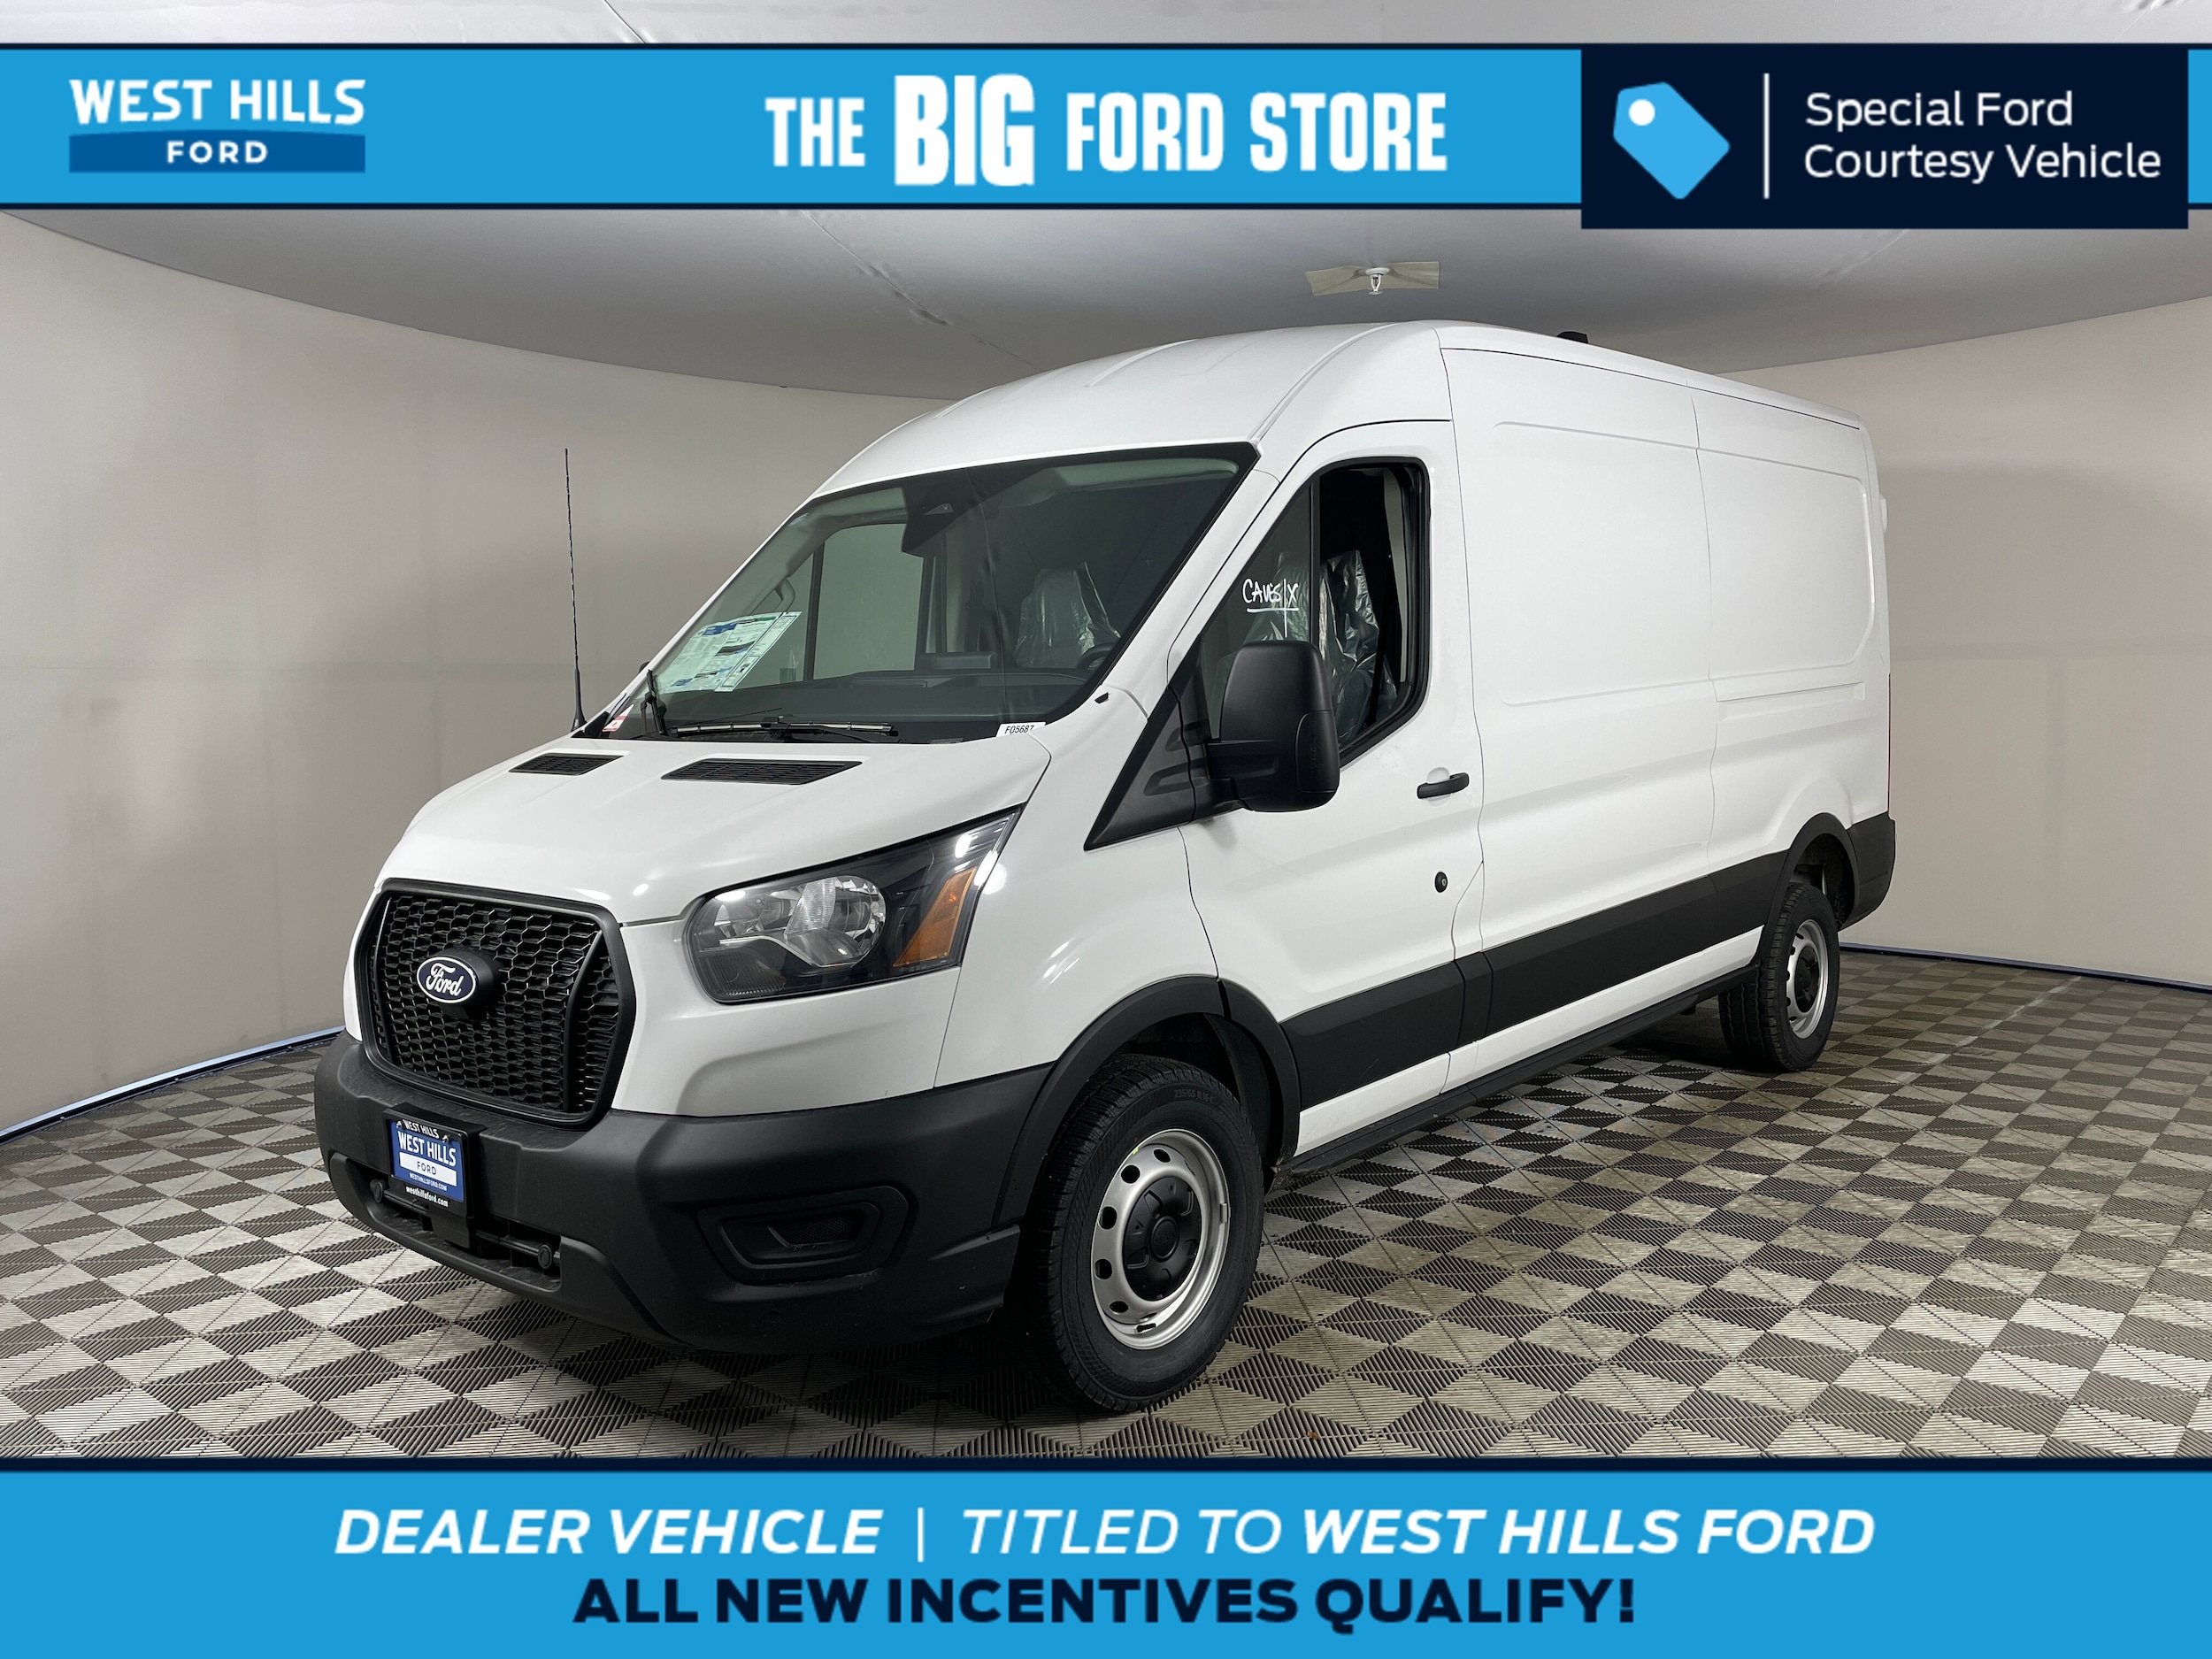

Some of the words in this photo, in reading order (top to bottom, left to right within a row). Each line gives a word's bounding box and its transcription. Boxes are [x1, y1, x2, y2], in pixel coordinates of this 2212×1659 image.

[425, 962, 465, 997] Ford
[403, 1118, 421, 1133] WEST
[420, 1124, 440, 1139] HILLS
[397, 1130, 426, 1156] WEST
[426, 1141, 457, 1167] HILLS
[417, 1161, 437, 1176] FORD
[405, 1186, 449, 1208] westhillsford.com
